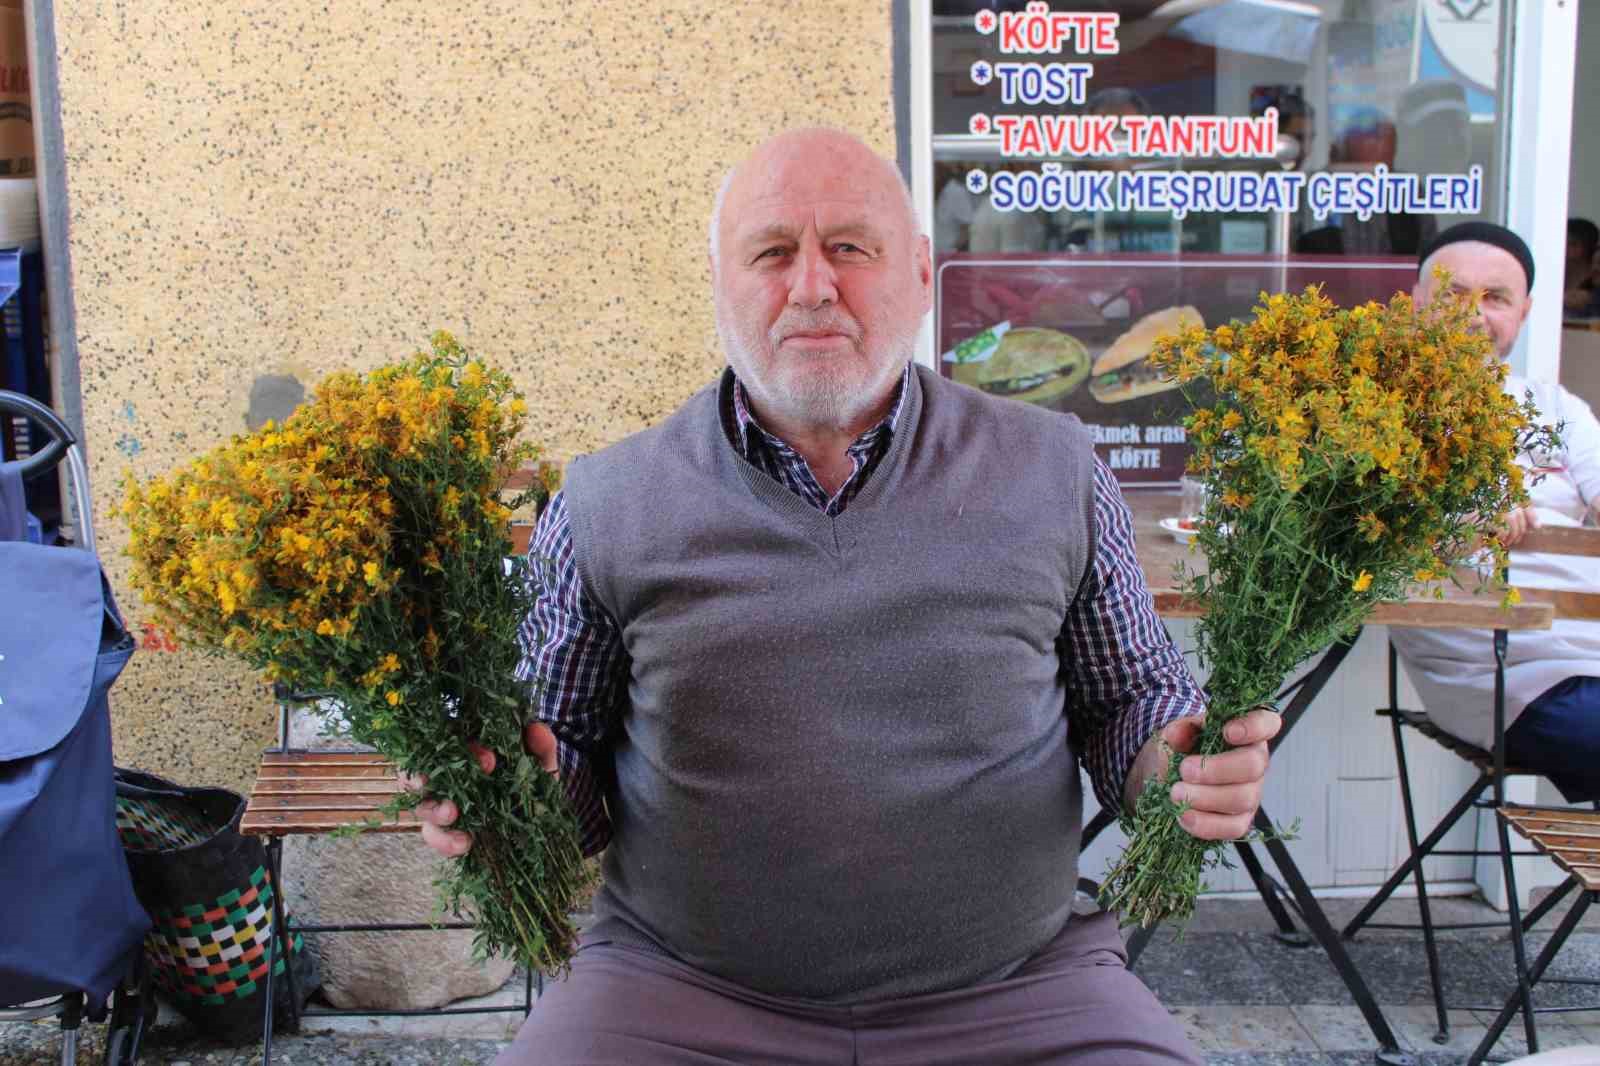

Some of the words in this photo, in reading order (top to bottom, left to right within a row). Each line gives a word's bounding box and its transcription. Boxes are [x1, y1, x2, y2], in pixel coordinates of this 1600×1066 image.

[1001, 4, 1117, 51] KÖFTE
[998, 65, 1091, 102] TOST
[996, 117, 1116, 154] TAVUK
[1123, 110, 1276, 155] TANTUNİ
[993, 165, 1113, 209] SOĞUK
[1119, 174, 1303, 216] MEŞRUBAT
[1311, 167, 1483, 218] ÇEŞİTLERİ
[1109, 445, 1160, 469] KÖFTE
